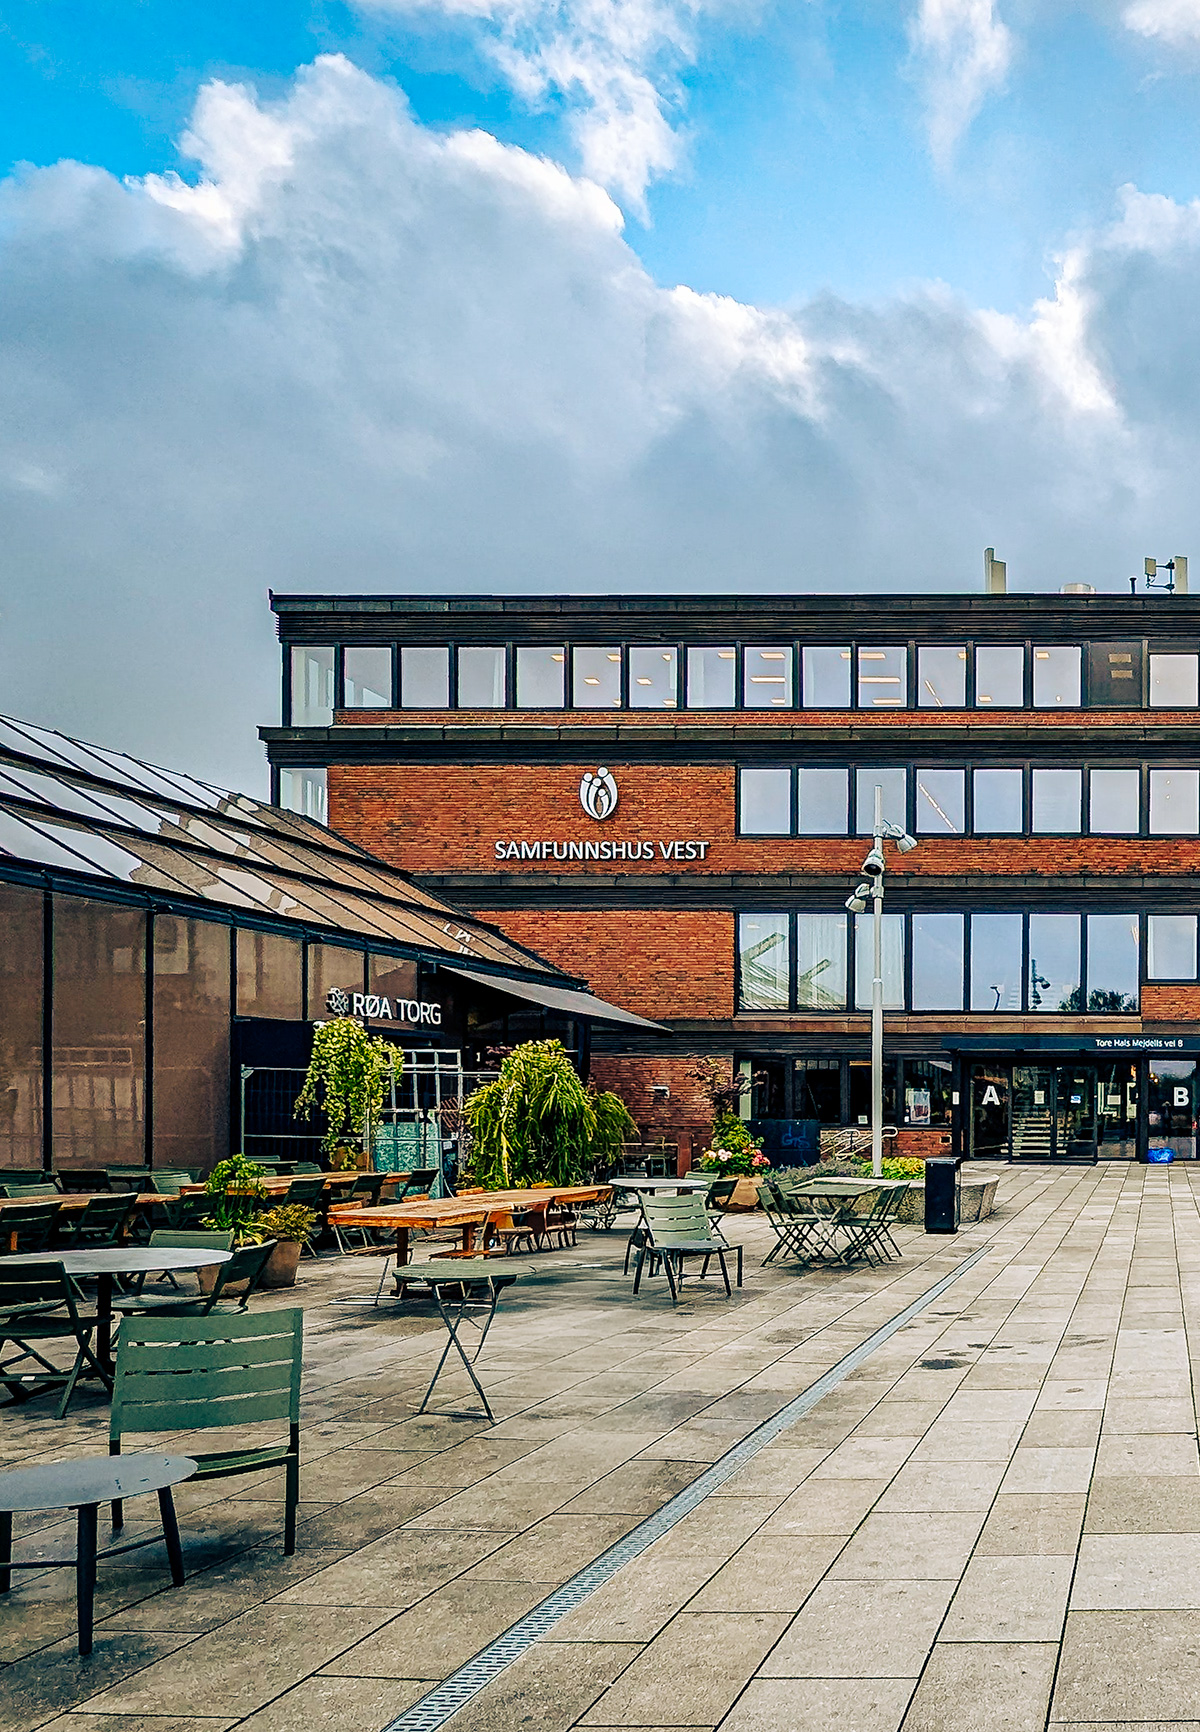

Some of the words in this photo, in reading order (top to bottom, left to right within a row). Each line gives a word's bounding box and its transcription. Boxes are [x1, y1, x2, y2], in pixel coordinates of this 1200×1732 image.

[494, 841, 654, 860] SAMFUNNSHUS
[659, 841, 709, 860] VEST
[353, 993, 393, 1020] RØA
[396, 999, 442, 1025] TORG
[1095, 1039, 1112, 1047] Tore
[1177, 1039, 1184, 1047] 8
[981, 1085, 1001, 1106] A
[1173, 1086, 1189, 1107] B
